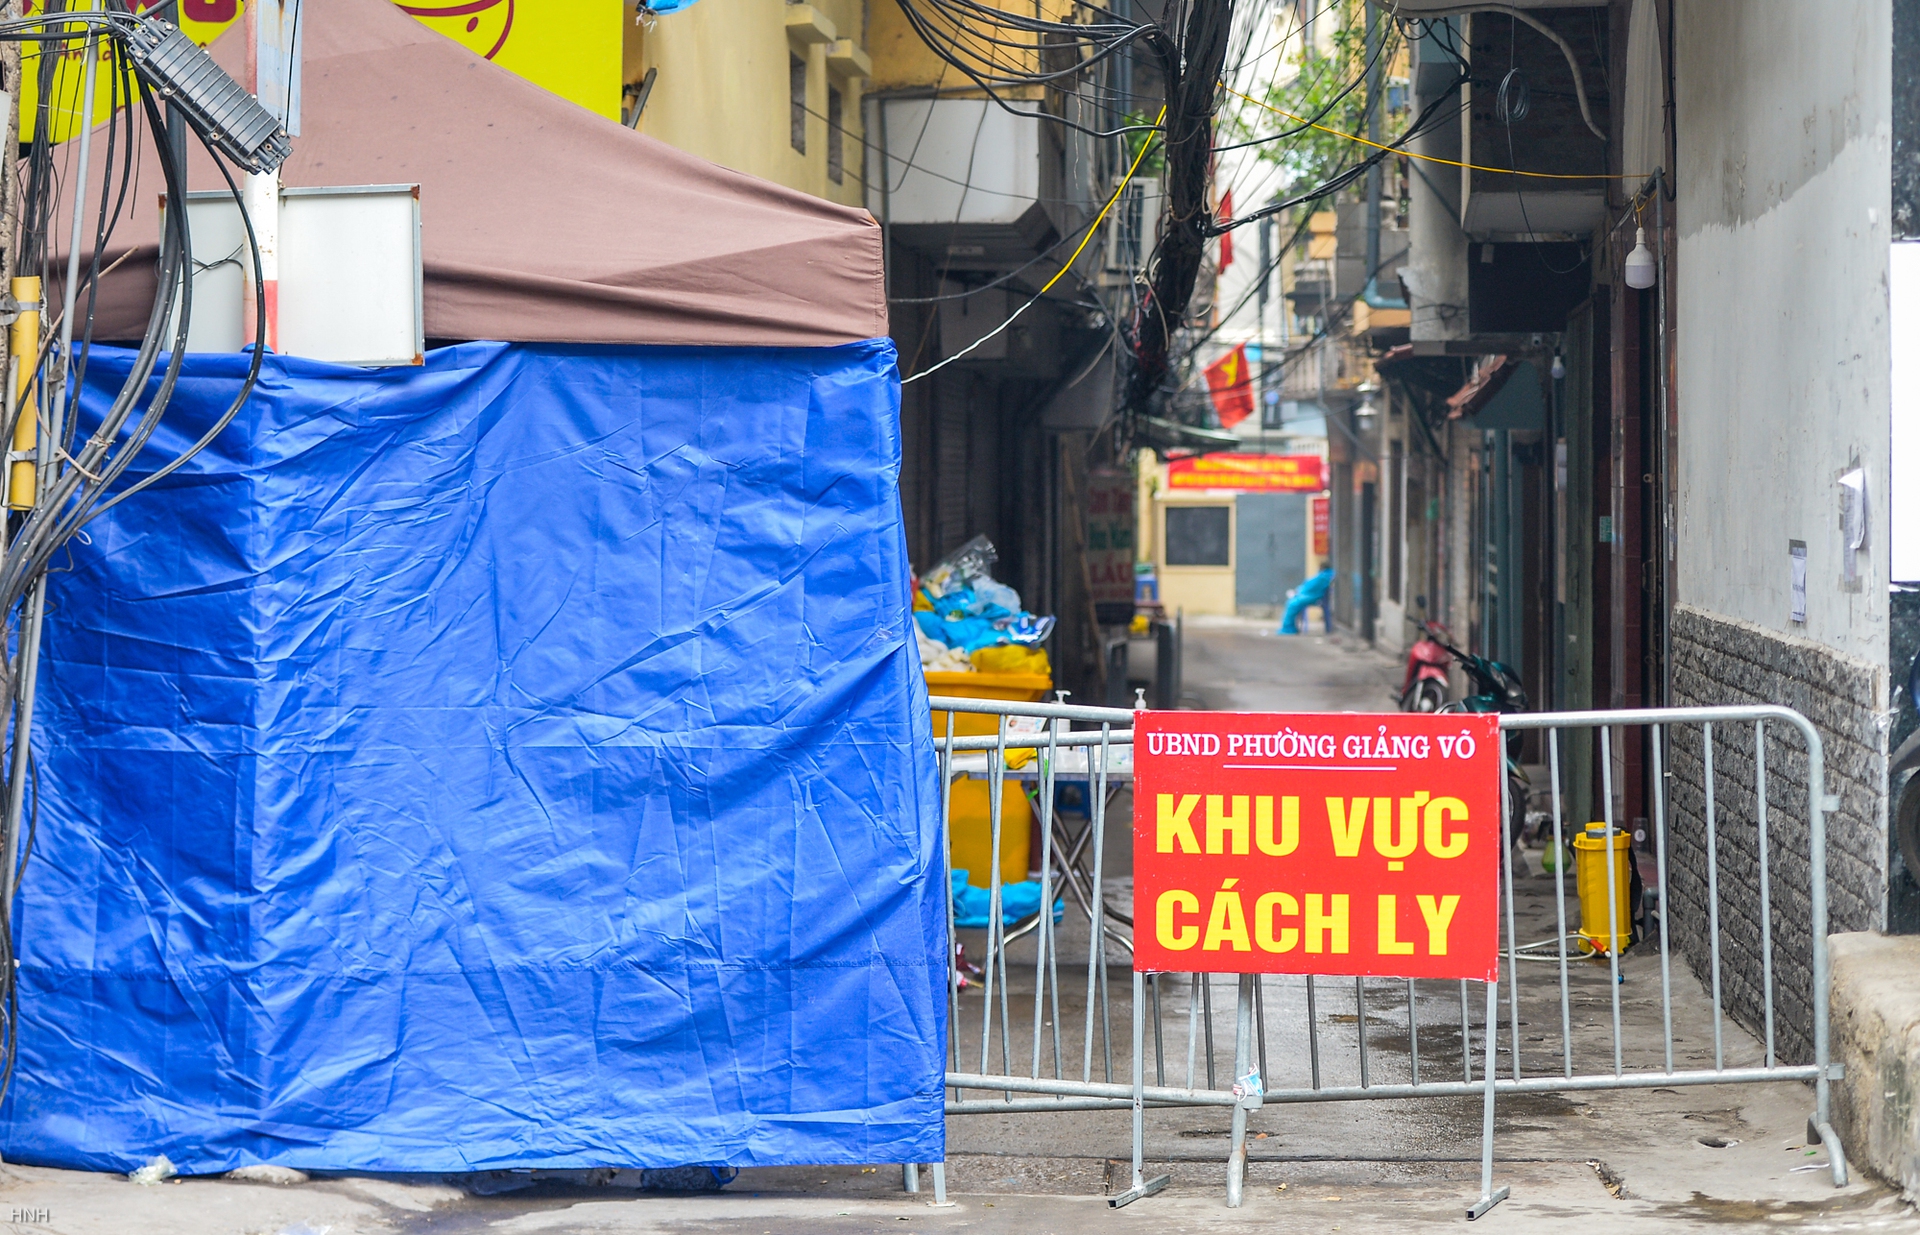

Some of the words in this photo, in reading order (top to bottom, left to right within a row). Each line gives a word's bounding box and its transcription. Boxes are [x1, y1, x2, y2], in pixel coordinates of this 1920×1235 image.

[1147, 732, 1220, 756] UBND
[1227, 726, 1337, 759] PHƯỜNG
[1343, 725, 1431, 759] GIẢNG
[1437, 729, 1476, 759] VÕ
[1156, 793, 1300, 857] KHU
[1325, 790, 1469, 871] VỰC
[1155, 878, 1349, 954] CÁCH
[1377, 894, 1461, 956] LY
